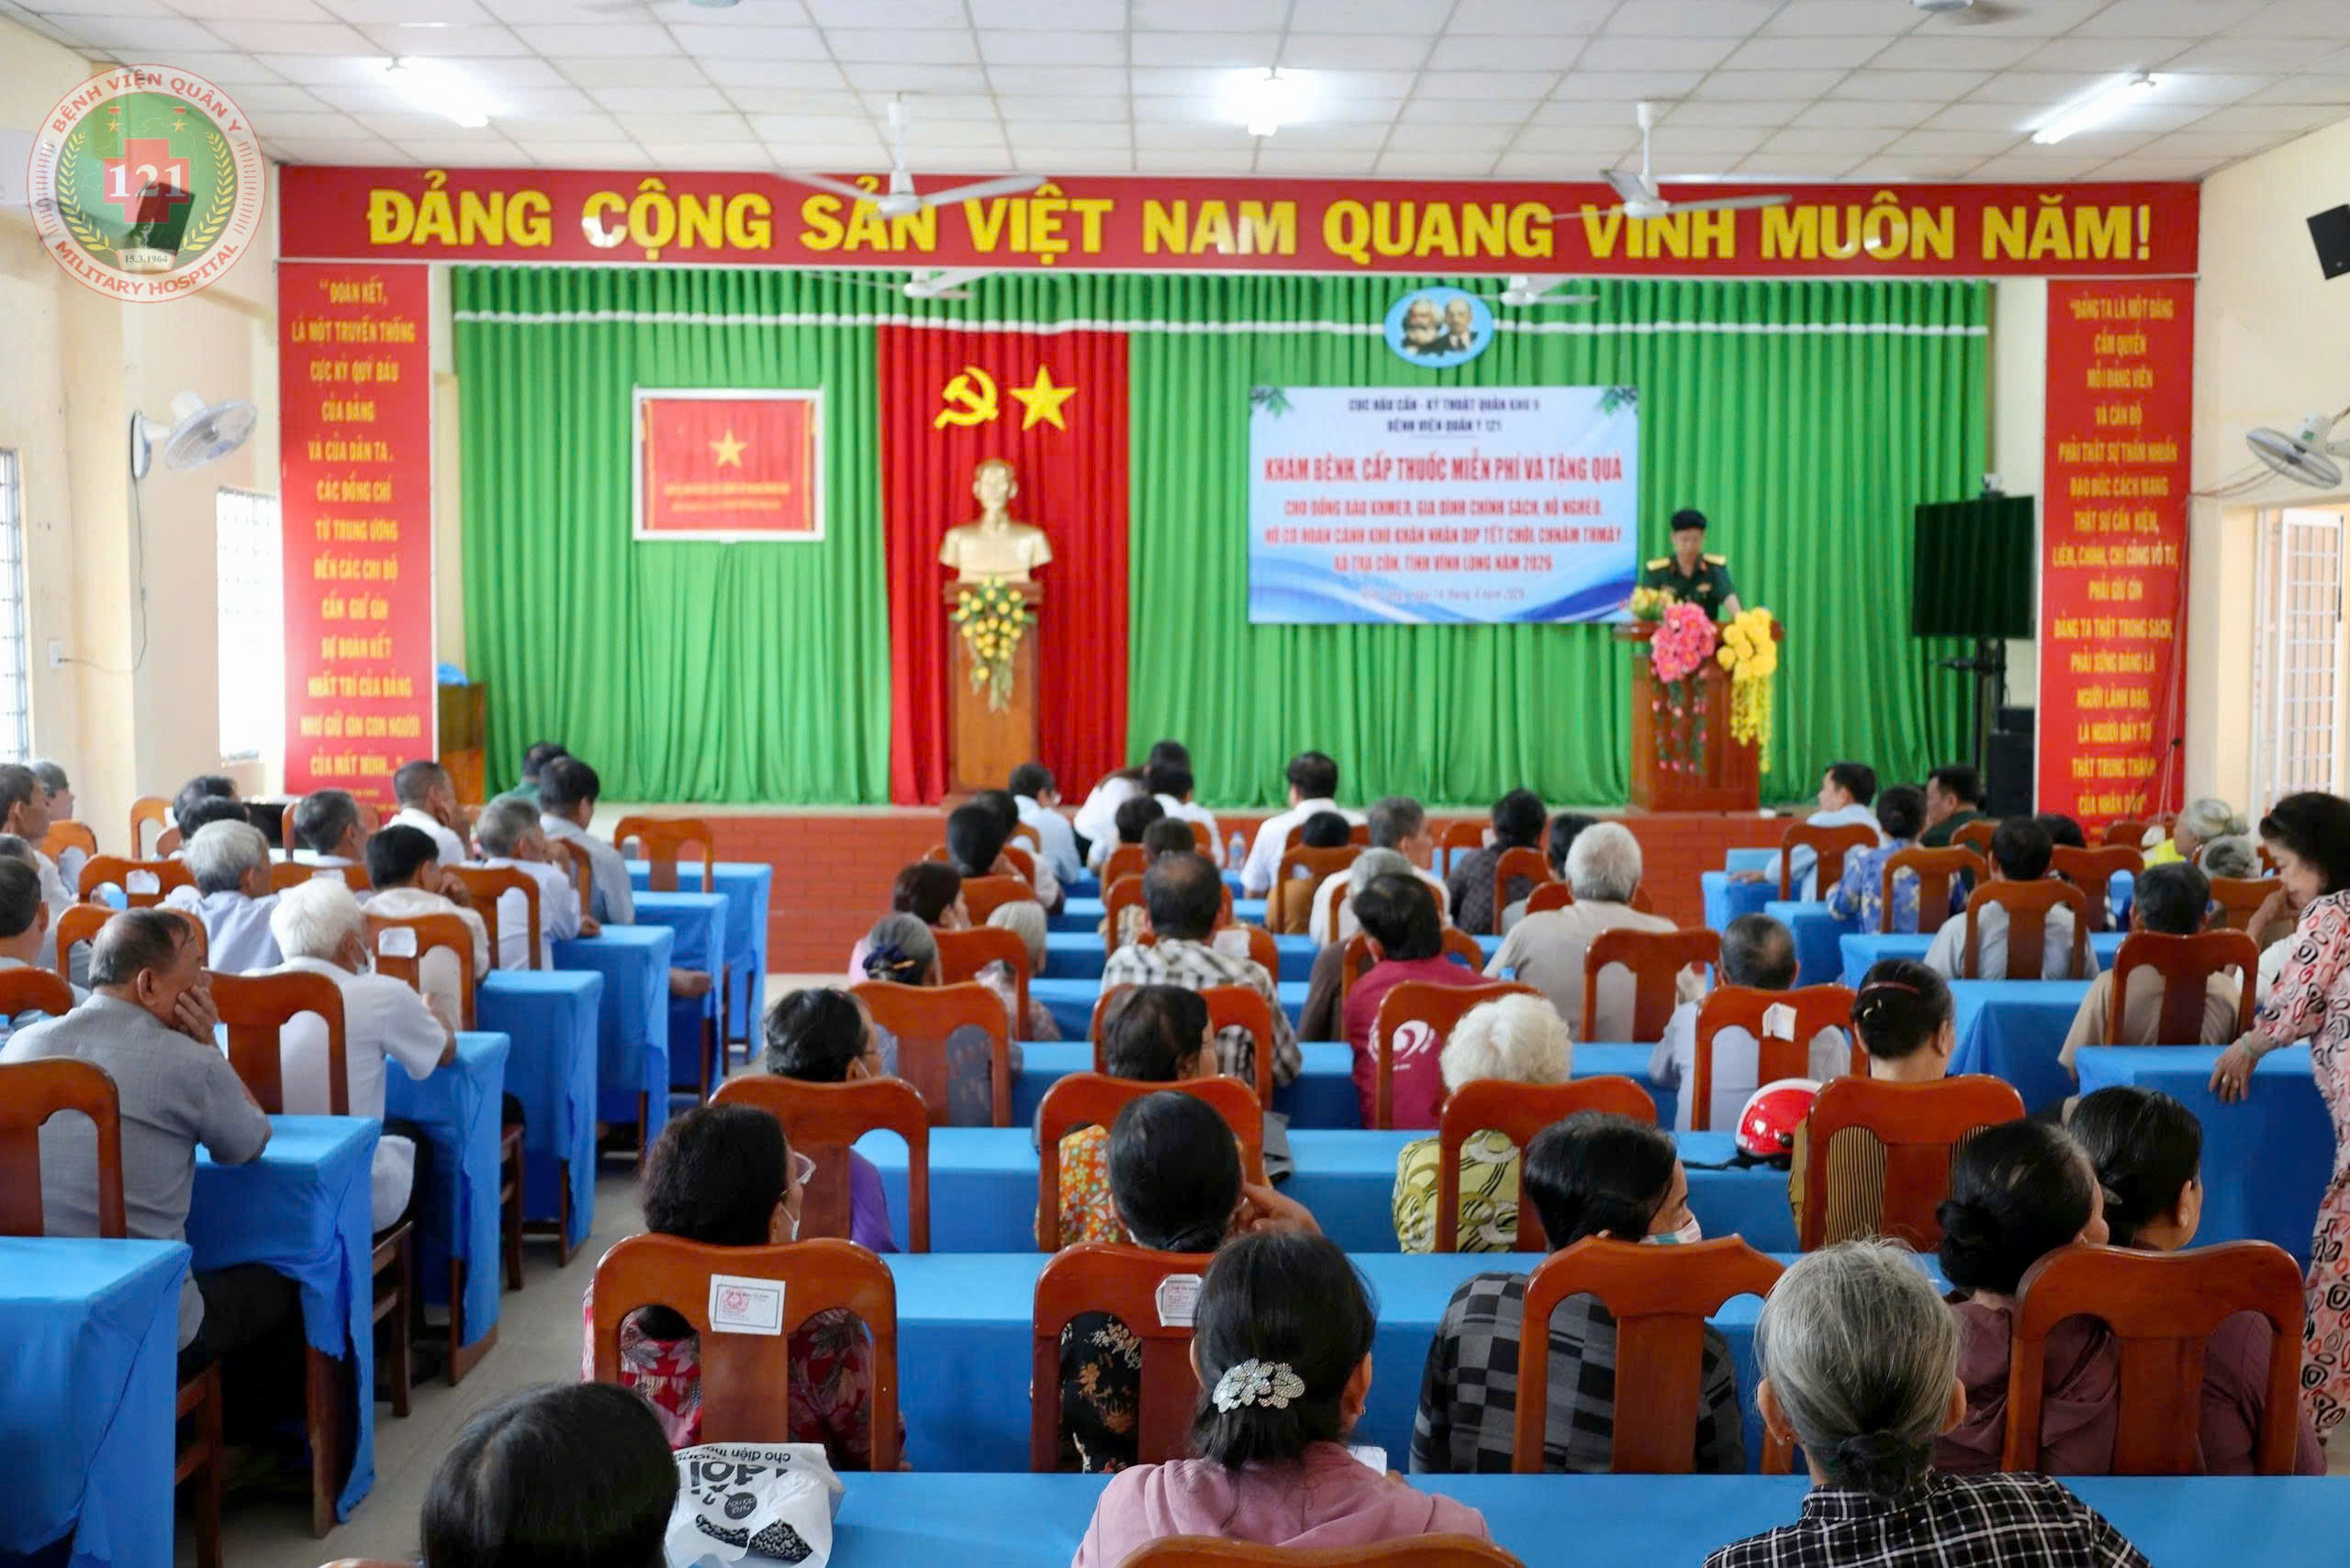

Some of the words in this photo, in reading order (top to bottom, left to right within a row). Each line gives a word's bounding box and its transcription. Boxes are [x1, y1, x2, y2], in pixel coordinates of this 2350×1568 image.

[367, 170, 552, 247] ĐẢNG
[581, 177, 771, 261] CỘNG
[799, 174, 935, 252] SẢN
[961, 183, 1113, 265] VIỆT
[1142, 199, 1297, 256] NAM
[1322, 199, 1554, 264] QUANG
[1580, 204, 1736, 261] VINH
[1760, 190, 1955, 261] MUÔN
[1982, 192, 2151, 261] NĂM!
[1264, 449, 1310, 482] KHÁM
[1362, 447, 1393, 482] CẤP
[1396, 448, 1448, 482] THUỐC
[1450, 446, 1491, 482] MIỄN
[1494, 449, 1520, 482] PHÍ
[1524, 450, 1544, 482] VÀ
[1548, 451, 1588, 487] TẶNG
[1591, 447, 1623, 485] QUÀ
[765, 1451, 791, 1462] cho
